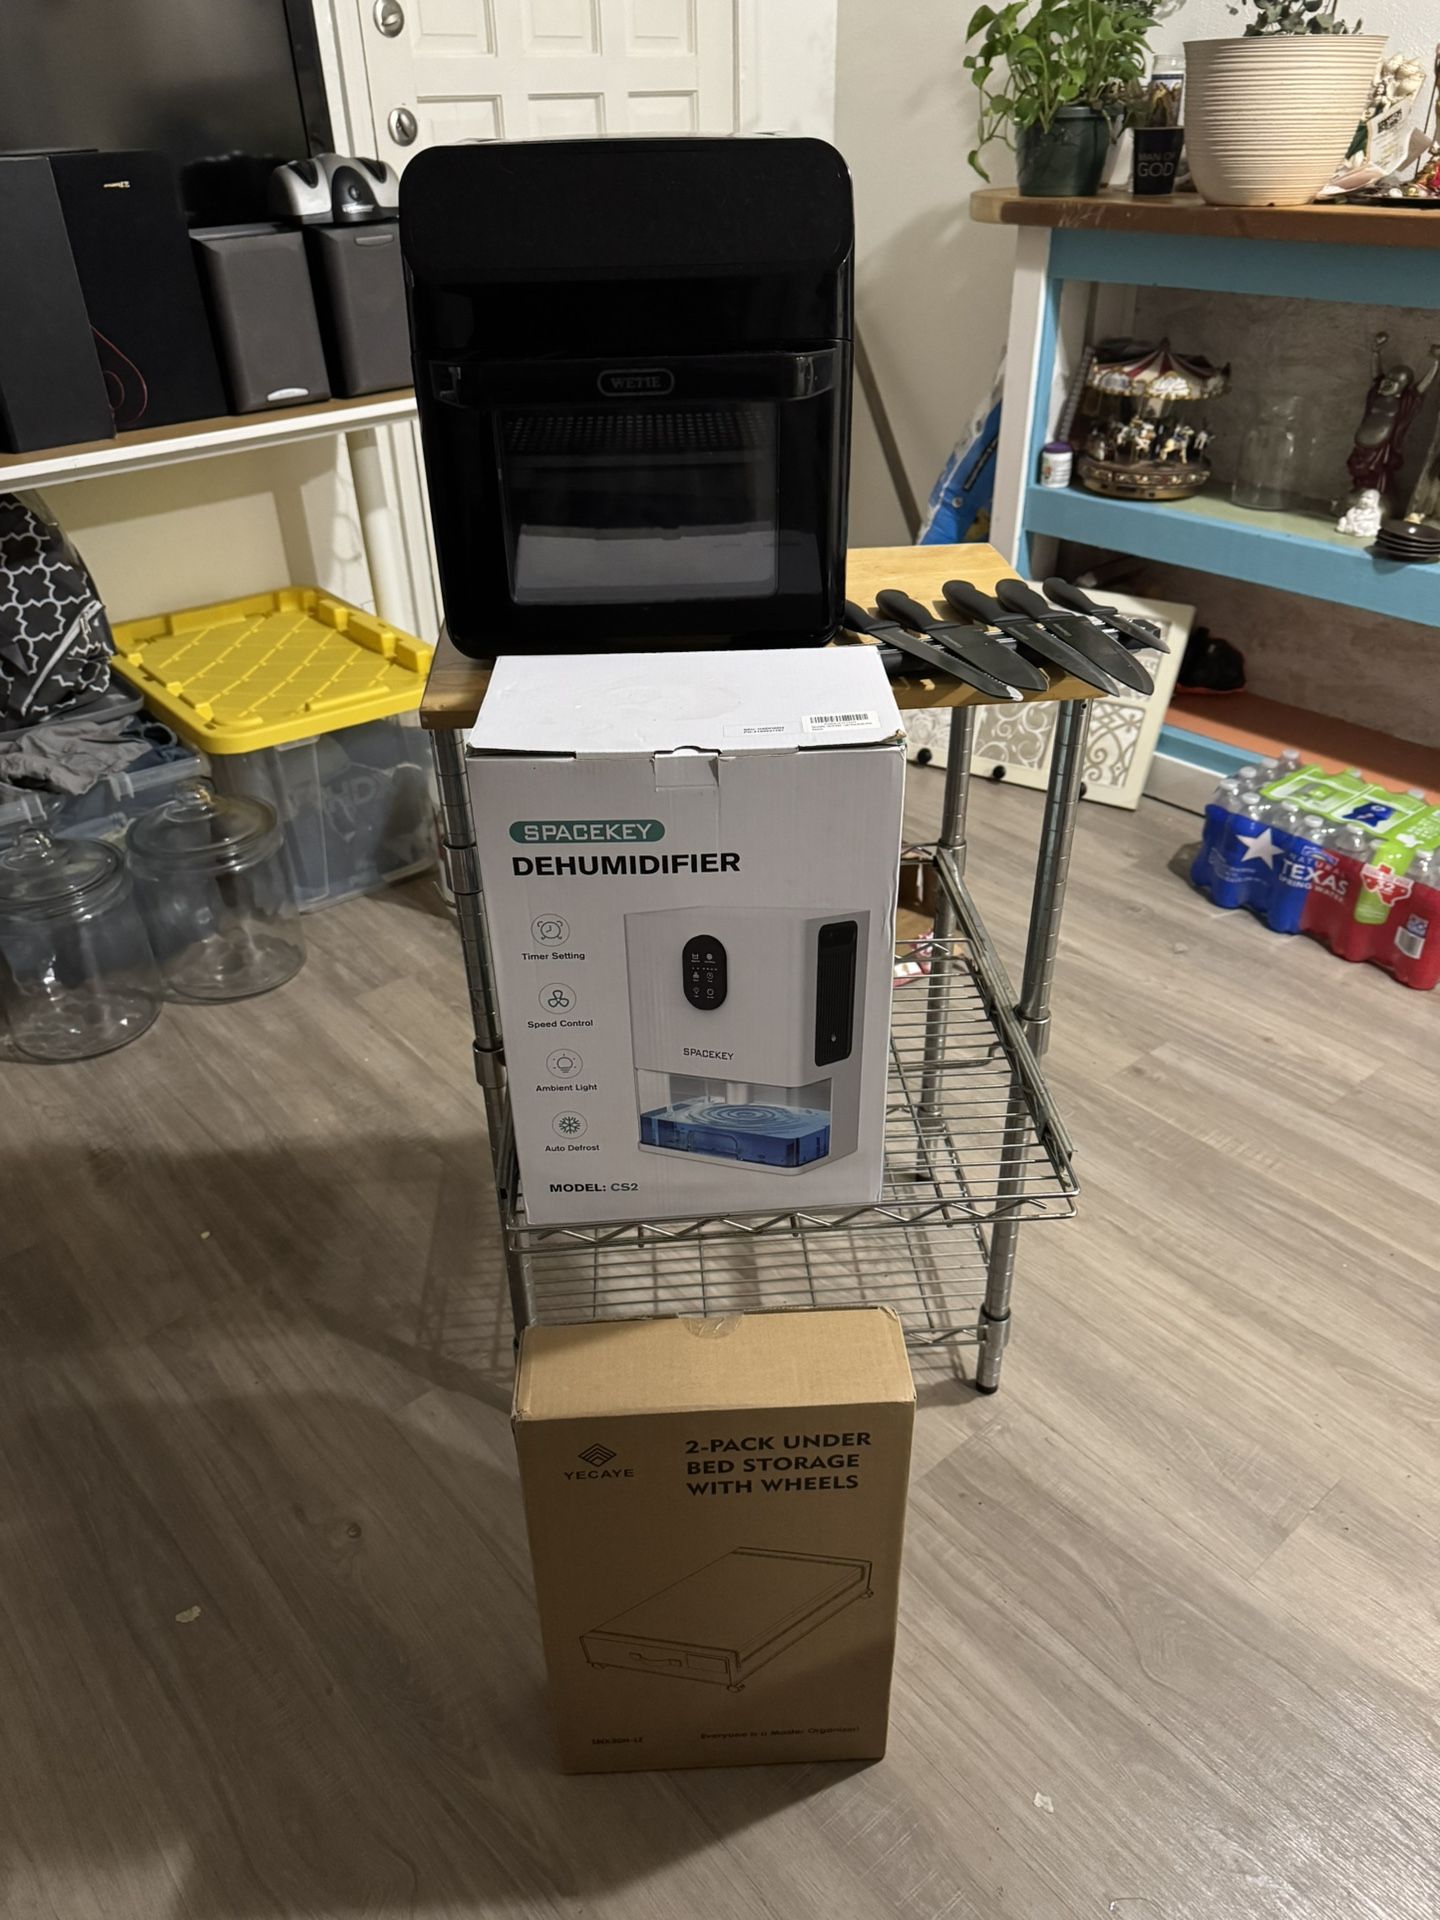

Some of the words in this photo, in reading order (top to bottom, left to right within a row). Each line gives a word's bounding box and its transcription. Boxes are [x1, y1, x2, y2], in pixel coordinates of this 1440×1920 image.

[1137, 161, 1175, 177] GOD
[523, 823, 652, 841] SPACEKEY
[511, 852, 741, 876] DEHUMIDIFIER
[1281, 858, 1349, 896] TEXAS
[1278, 873, 1313, 890] SPRING
[1314, 884, 1345, 903] WATER
[521, 952, 549, 960] Timer
[551, 952, 586, 961] Setting
[527, 1020, 557, 1029] Speed
[559, 1019, 593, 1027] Control
[683, 1047, 734, 1060] SPACEKEY
[535, 1084, 573, 1092] Ambient
[575, 1084, 598, 1092] Light
[567, 1144, 600, 1152] Defrost
[549, 1183, 607, 1192] MODEL:
[610, 1182, 639, 1191] CS2
[685, 1436, 776, 1454] 2-PACK
[783, 1431, 872, 1449] UNDER
[687, 1459, 735, 1476] BED
[742, 1453, 860, 1473] STORAGE
[563, 1468, 635, 1481] YECAYE
[686, 1479, 752, 1497] WITH
[760, 1474, 859, 1493] WHEELS
